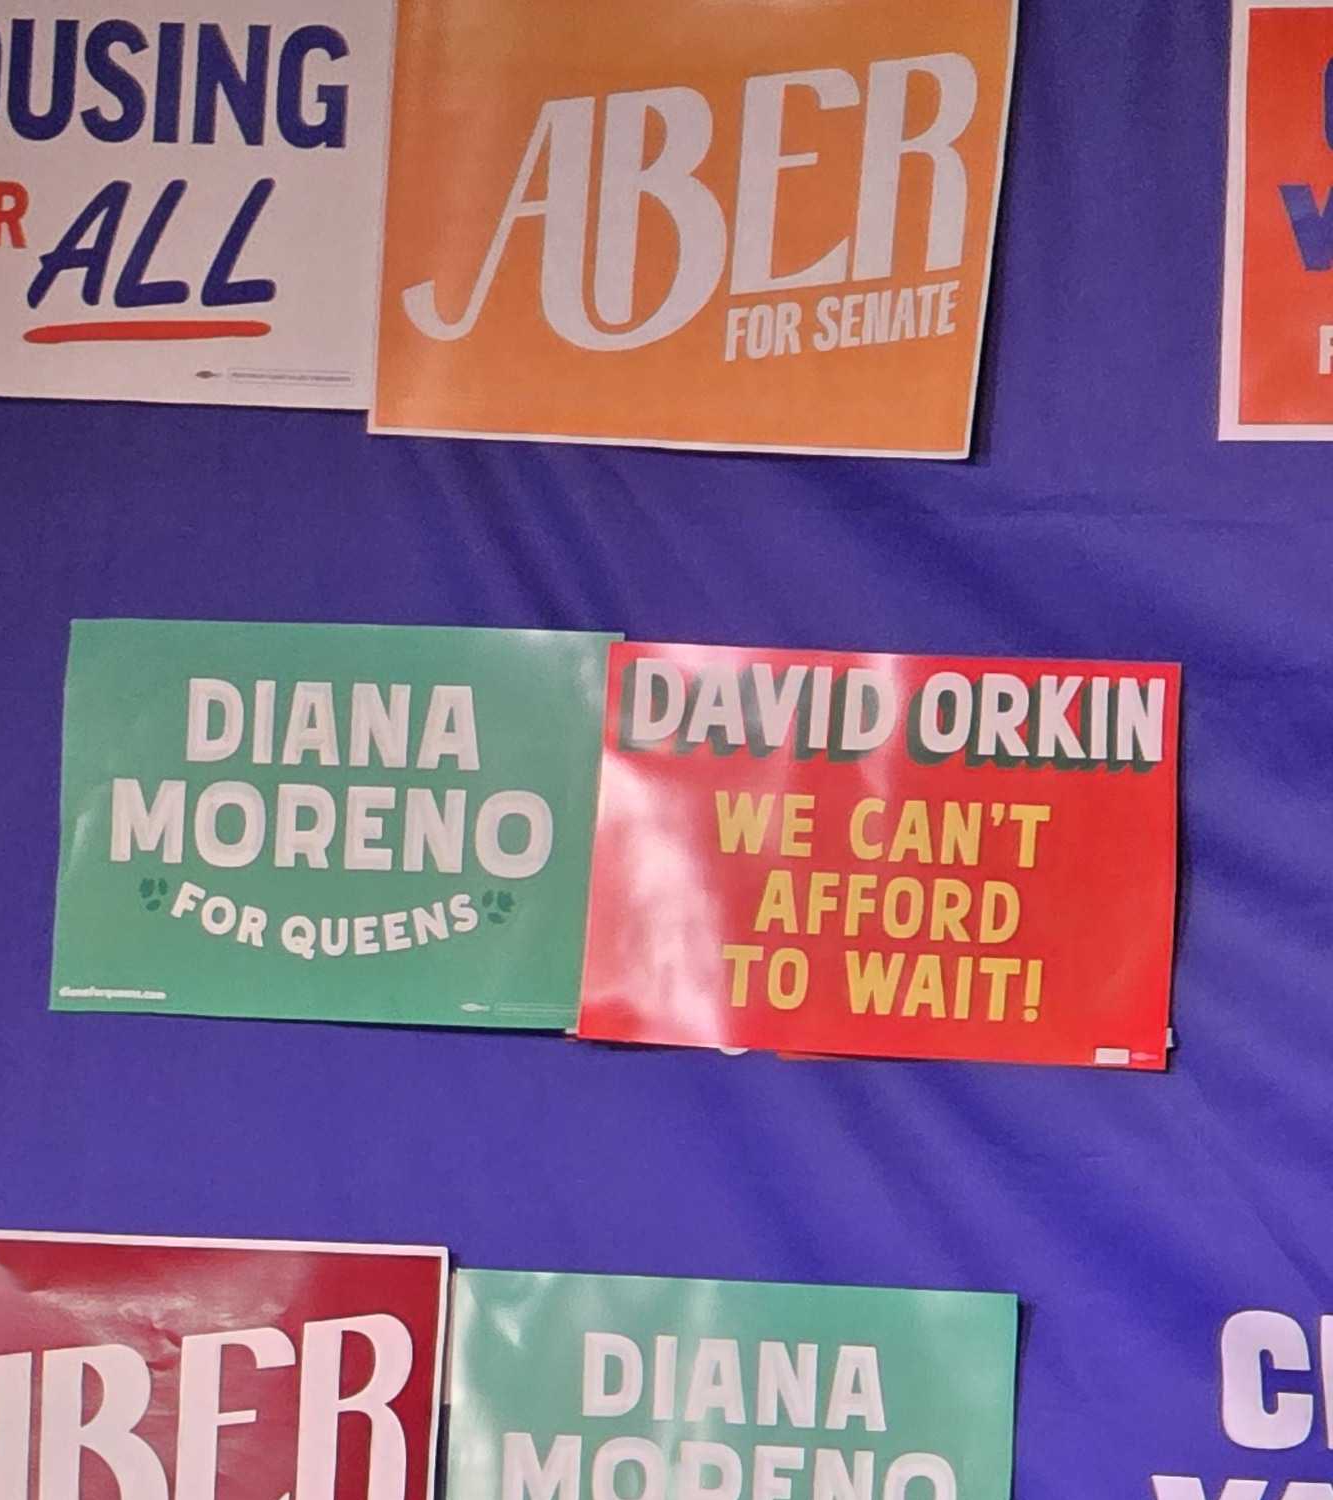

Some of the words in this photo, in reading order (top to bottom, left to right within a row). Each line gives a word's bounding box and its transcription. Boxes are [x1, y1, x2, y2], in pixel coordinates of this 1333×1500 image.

[27, 178, 276, 309] ALL
[402, 51, 979, 352] ABER
[724, 301, 803, 362] FOR
[813, 280, 960, 352] SENATE
[186, 677, 480, 770] DIANA
[625, 657, 896, 757] DAVID
[913, 672, 1167, 764] ORKIN
[110, 777, 554, 879] MORENO
[715, 790, 815, 857] WE
[849, 798, 1051, 868] CAN'T
[170, 881, 268, 947] FOR
[281, 893, 479, 960] QUEENS
[753, 870, 1020, 944] AFFORD
[723, 944, 809, 1010] TO
[845, 950, 1043, 1022] WAIT!
[582, 1331, 887, 1431] DIANA
